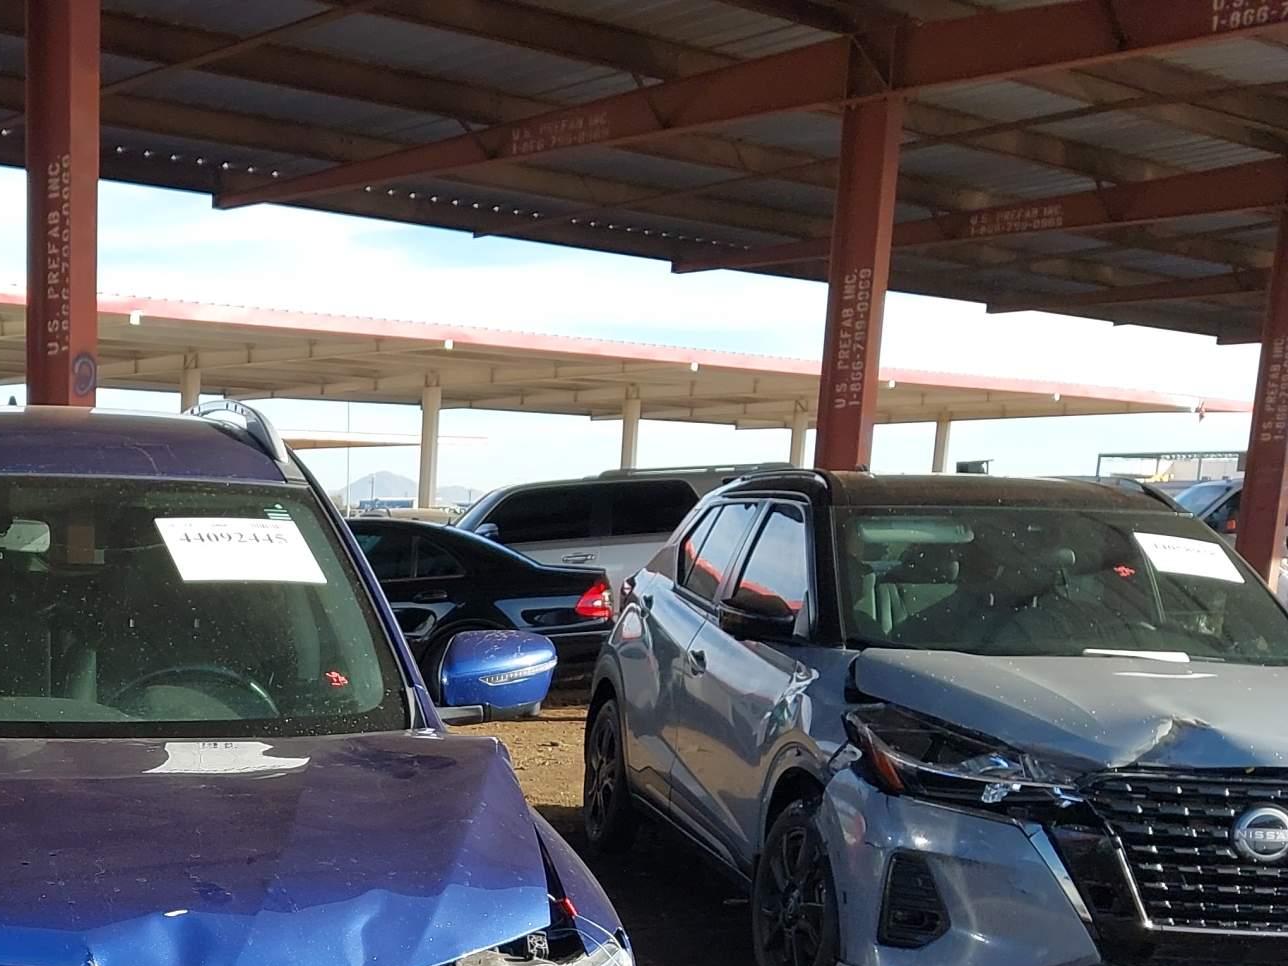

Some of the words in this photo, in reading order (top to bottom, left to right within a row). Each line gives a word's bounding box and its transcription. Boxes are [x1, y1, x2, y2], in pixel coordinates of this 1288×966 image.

[47, 155, 61, 199] INC.
[47, 210, 61, 300] PREFAB
[842, 268, 858, 300] INC.
[837, 307, 855, 371] PREFAB
[179, 532, 290, 544] 44092445
